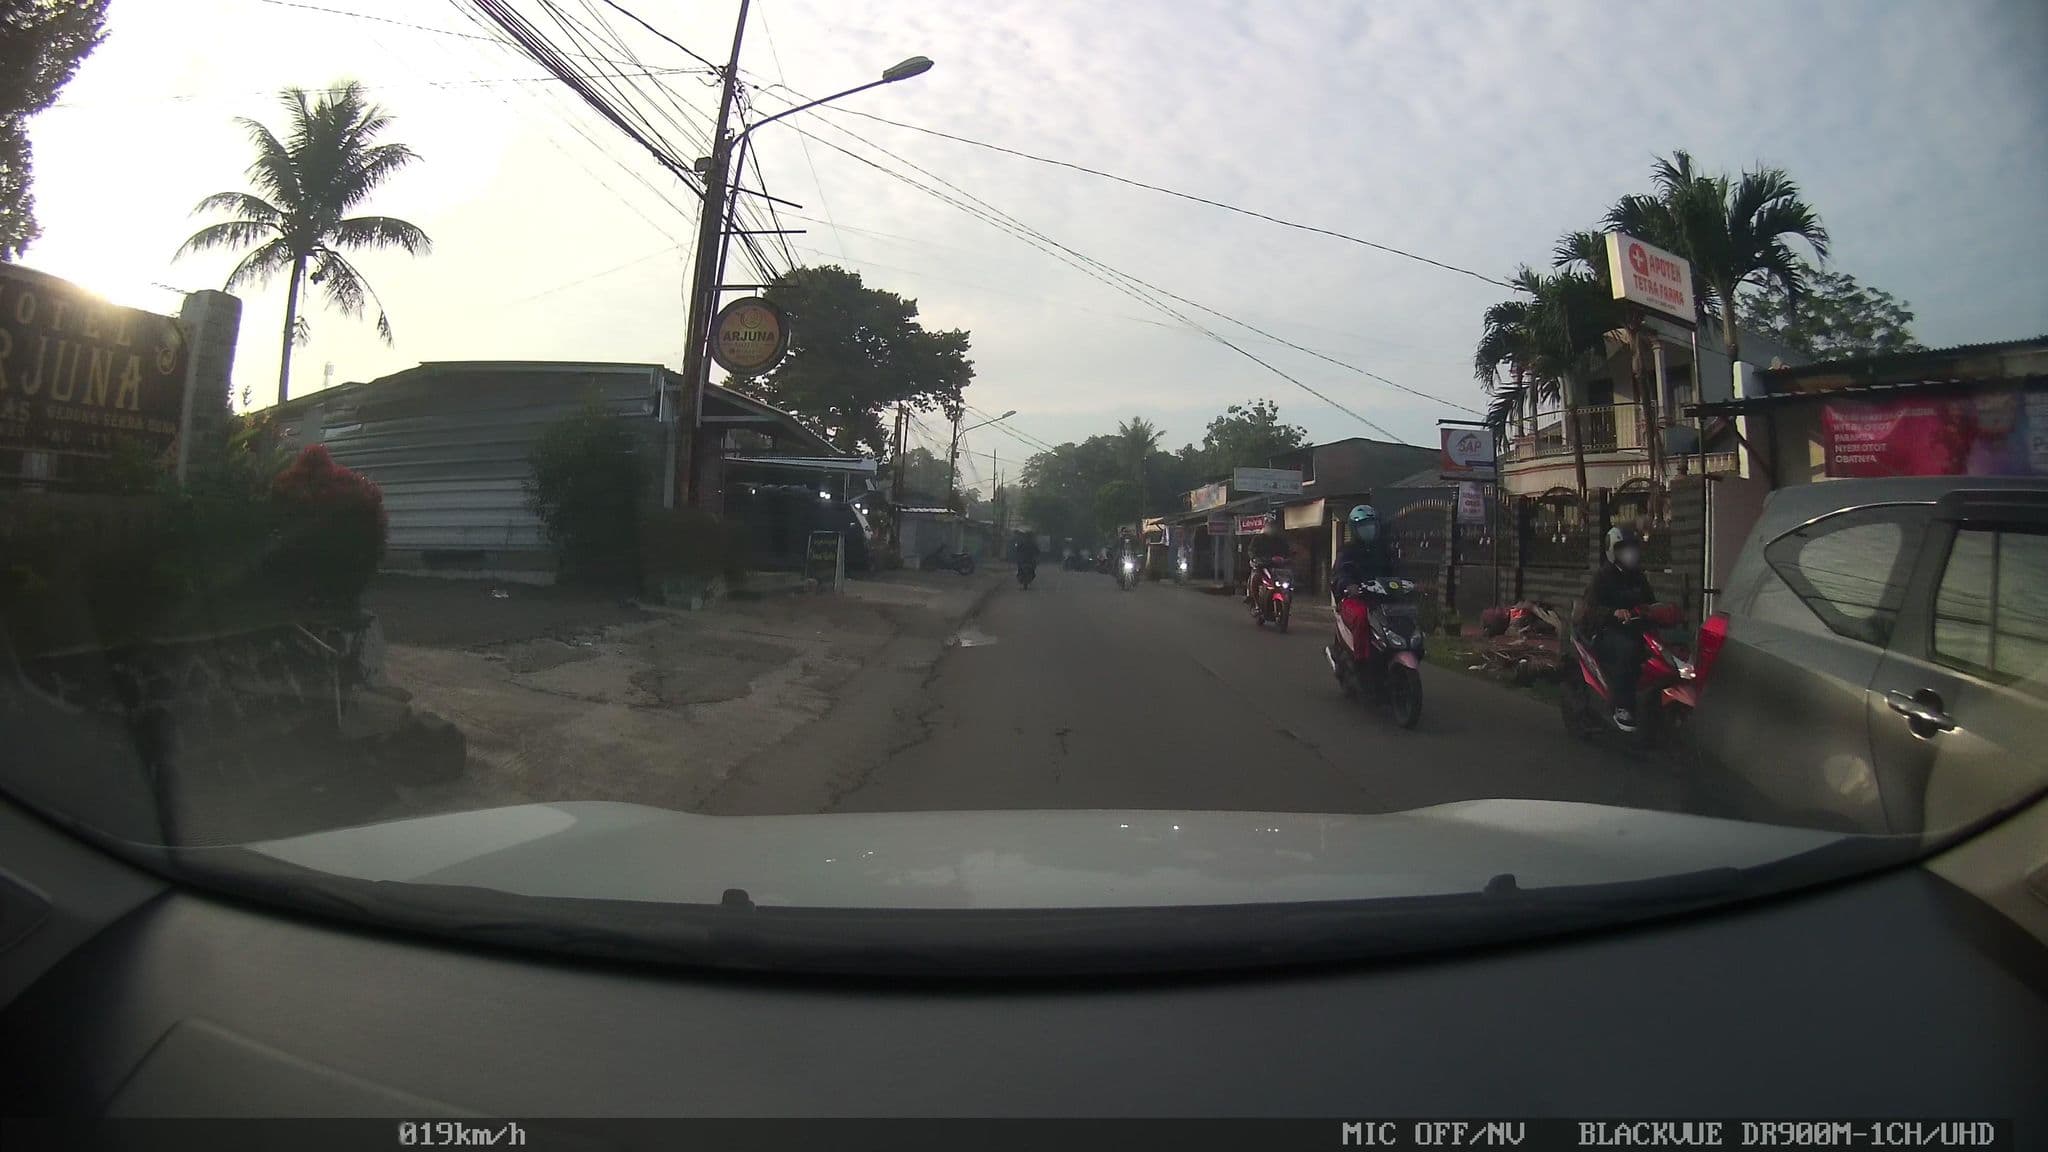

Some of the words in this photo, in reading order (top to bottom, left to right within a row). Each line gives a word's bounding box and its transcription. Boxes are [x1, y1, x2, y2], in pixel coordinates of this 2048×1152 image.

[723, 331, 774, 342] ARJUNA
[1458, 440, 1482, 453] SAP
[1835, 454, 1877, 464] OBATNYA
